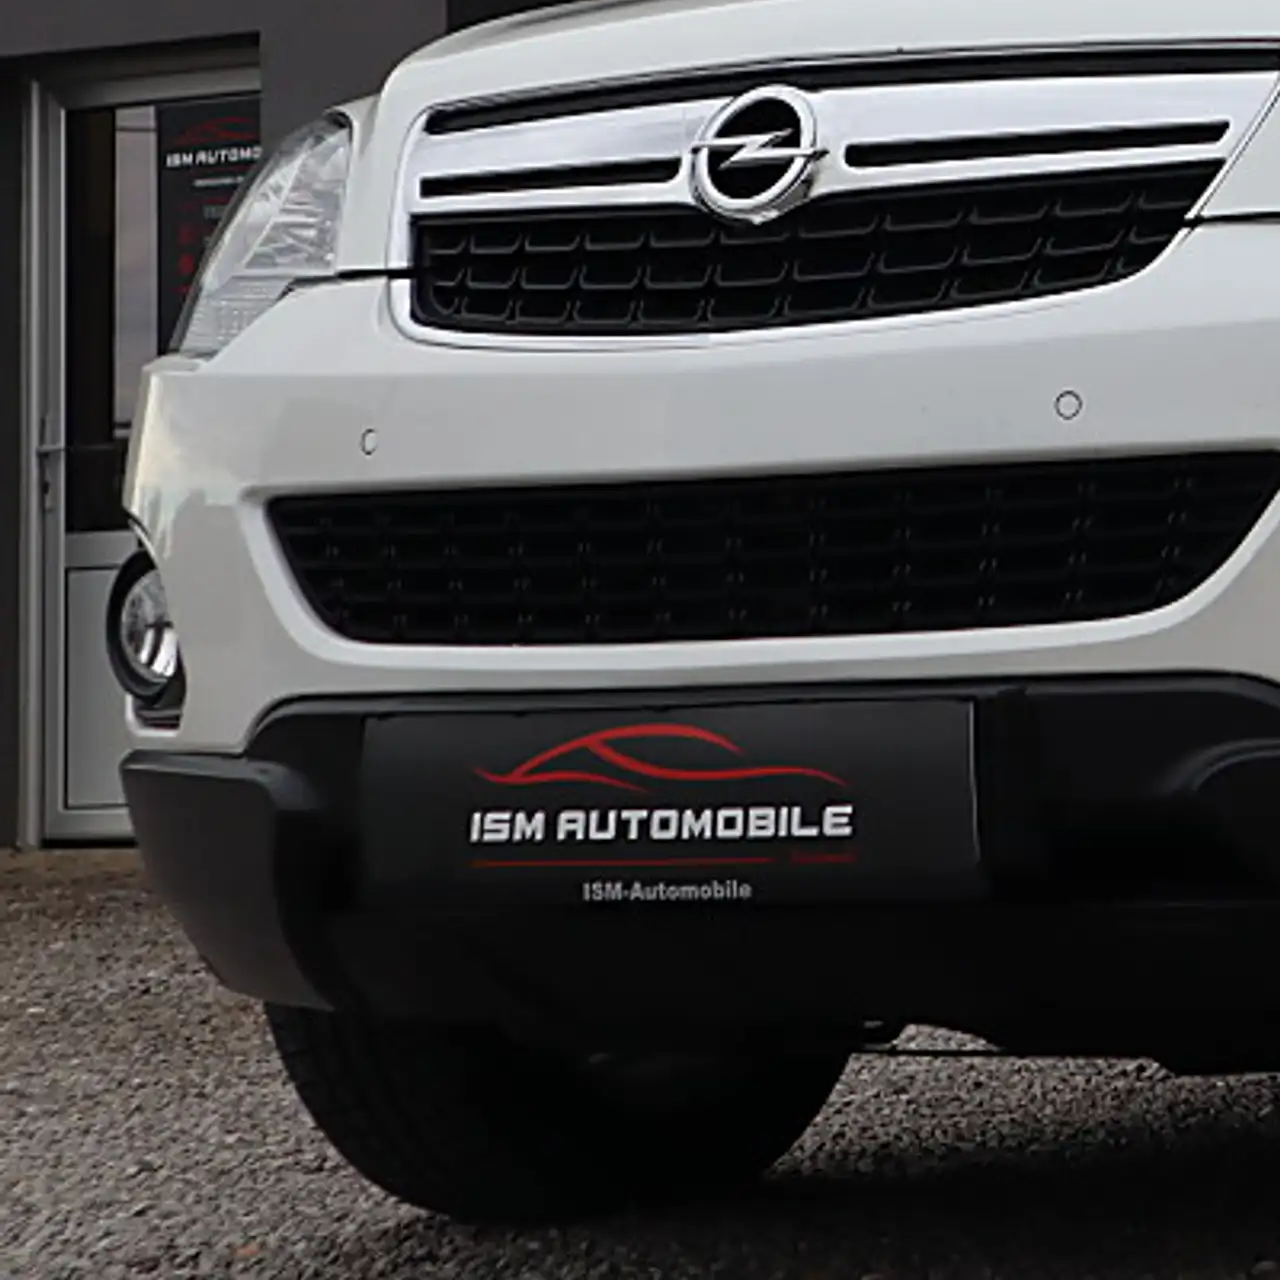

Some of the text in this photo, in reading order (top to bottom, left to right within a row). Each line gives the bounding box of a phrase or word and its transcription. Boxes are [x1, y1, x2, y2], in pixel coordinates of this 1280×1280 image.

[469, 804, 854, 842] ISM AUTOMOBILE
[582, 879, 753, 901] ISM-Automobile
